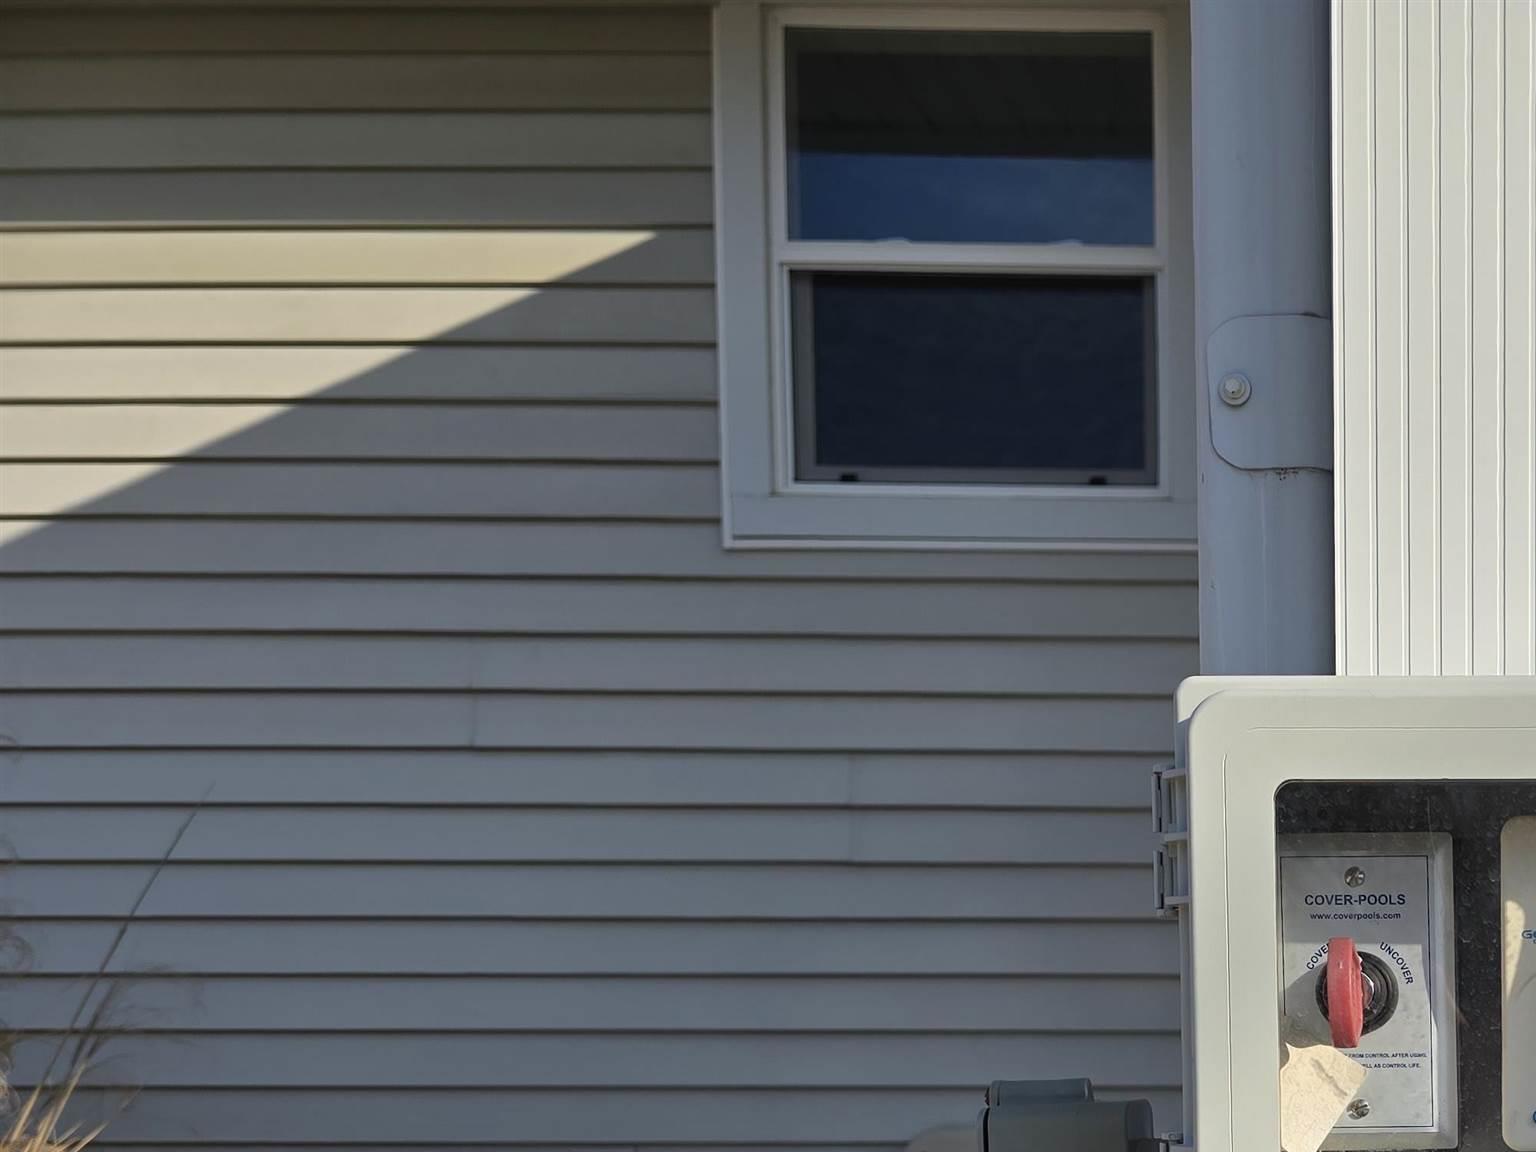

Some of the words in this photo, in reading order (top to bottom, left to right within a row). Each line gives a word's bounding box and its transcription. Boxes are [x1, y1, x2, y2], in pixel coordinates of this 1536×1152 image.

[1304, 894, 1406, 906] COVER-POOLS
[1310, 912, 1401, 920] www.coverpools.com
[1306, 943, 1329, 970] COVE
[1379, 942, 1414, 985] UNCOVER
